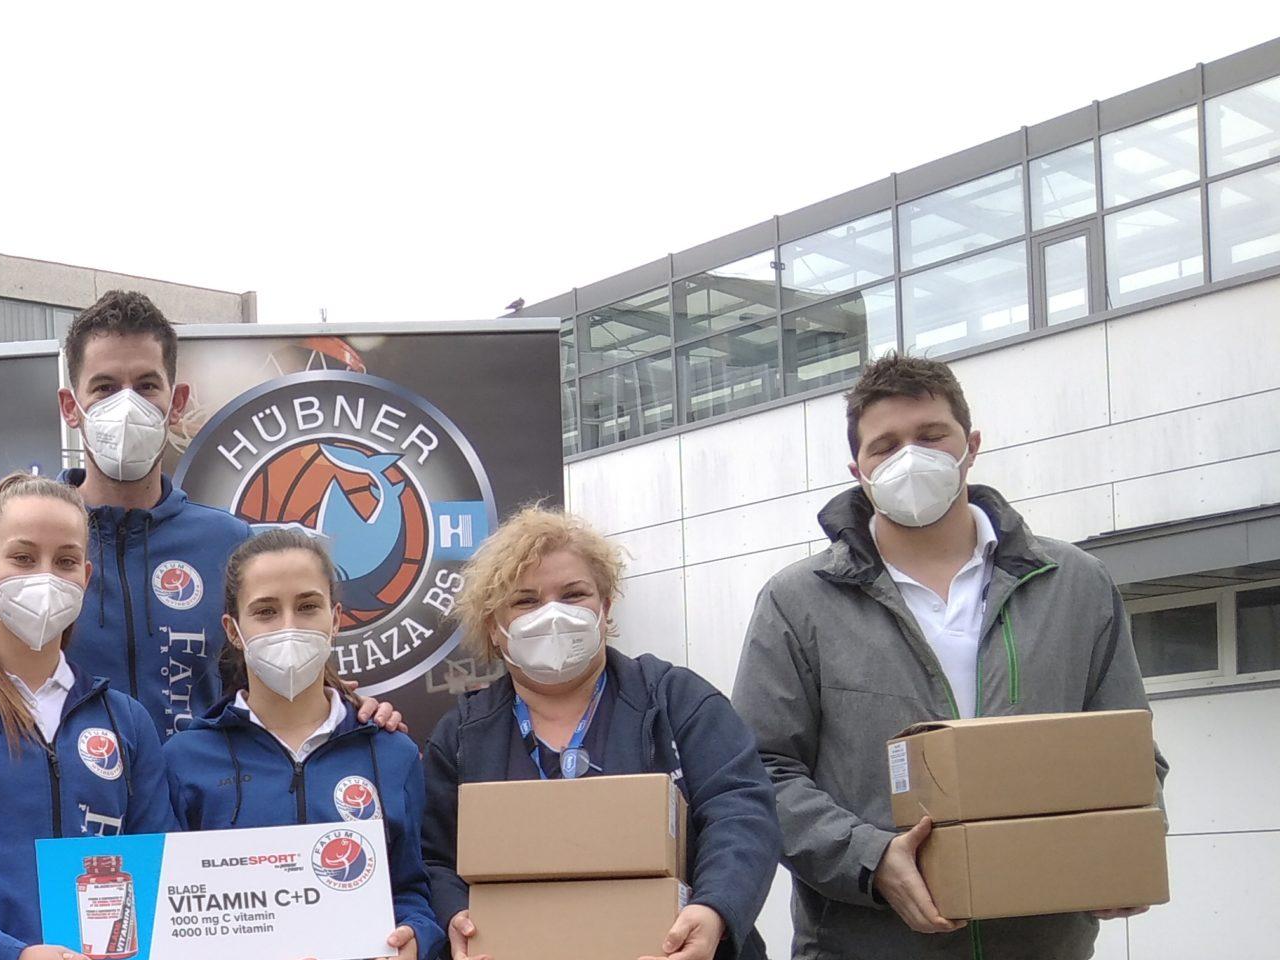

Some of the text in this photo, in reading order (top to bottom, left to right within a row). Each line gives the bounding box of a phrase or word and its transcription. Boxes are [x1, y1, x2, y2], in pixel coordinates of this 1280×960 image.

[216, 394, 440, 470] HÜBNER
[422, 568, 465, 616] BS
[314, 831, 354, 855] FATUM
[201, 853, 297, 868] BLADESPORT
[167, 884, 207, 896] BLADE
[167, 888, 321, 913] VITAMIN C+D
[170, 911, 276, 926] 1000 mg C vitamin
[171, 923, 274, 938] 4000 IU D vitamin
